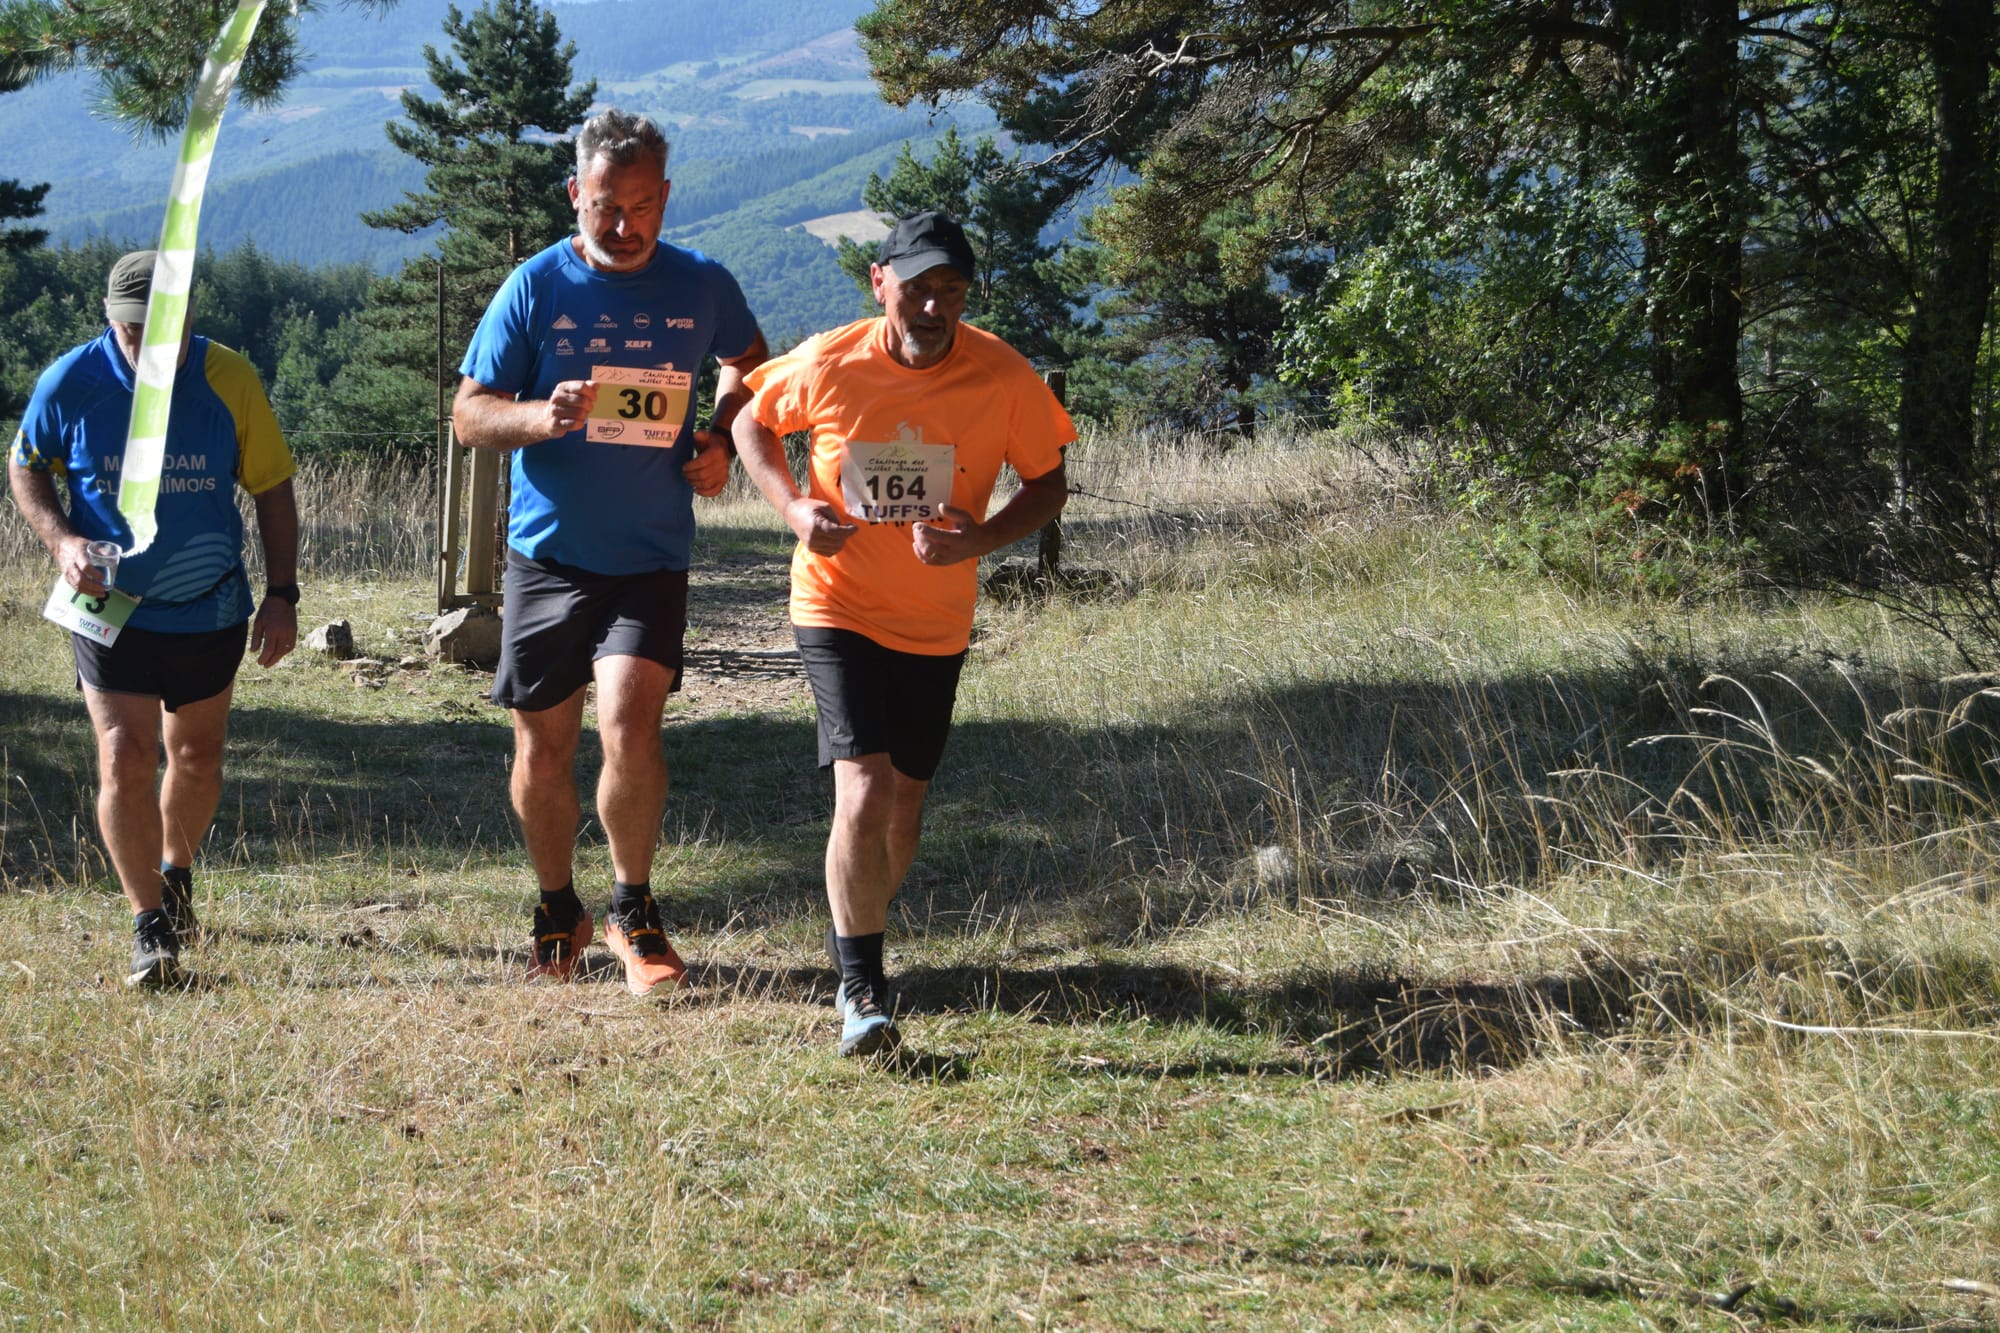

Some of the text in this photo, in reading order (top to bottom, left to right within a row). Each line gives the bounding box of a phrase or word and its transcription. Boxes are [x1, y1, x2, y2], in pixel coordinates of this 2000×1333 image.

[617, 388, 668, 421] 30
[104, 454, 206, 472] MDAM
[868, 457, 908, 467] Challenge
[866, 474, 926, 501] 164
[861, 504, 931, 518] TUFF'S
